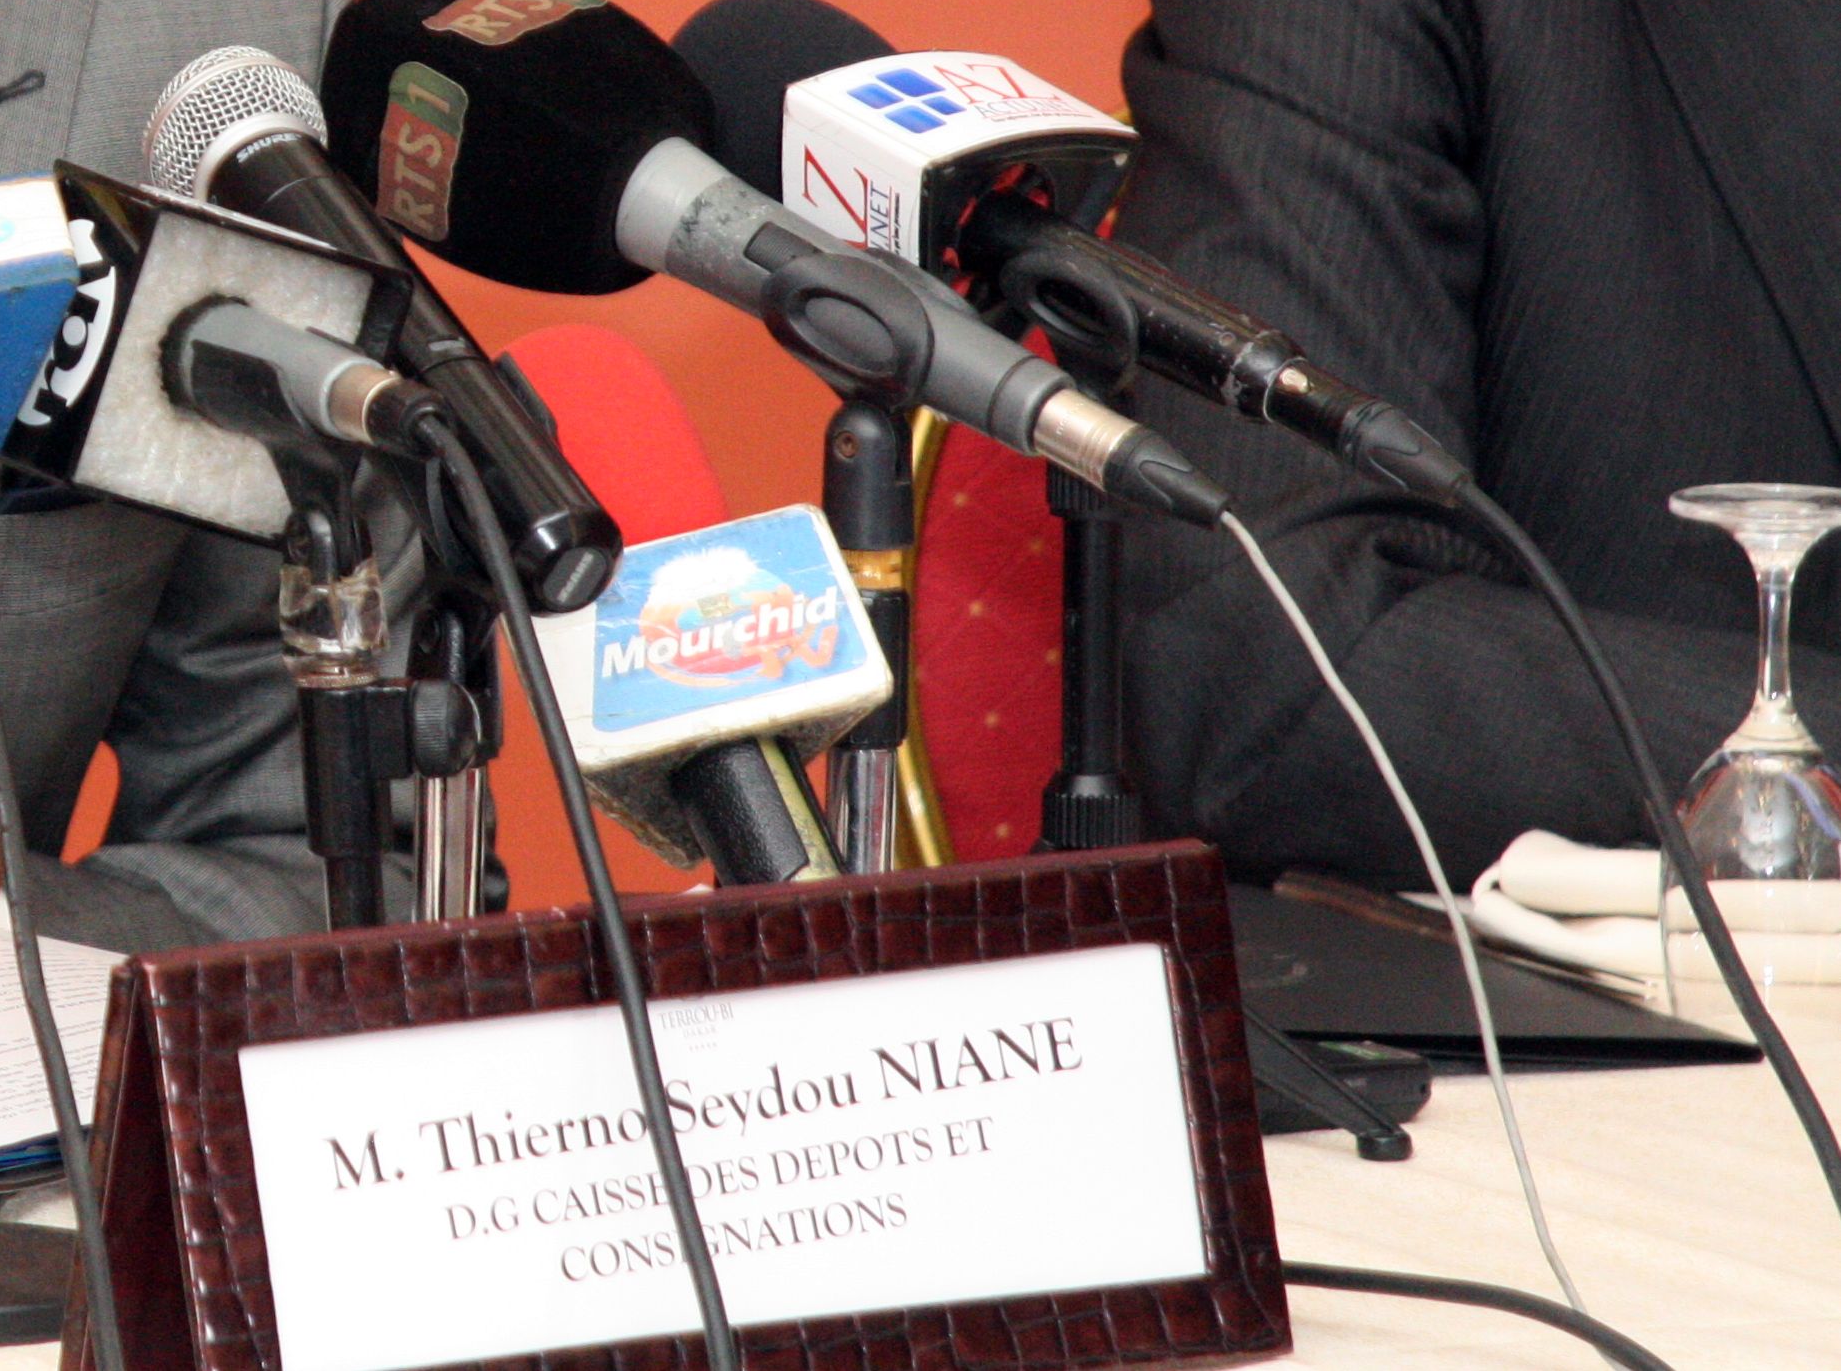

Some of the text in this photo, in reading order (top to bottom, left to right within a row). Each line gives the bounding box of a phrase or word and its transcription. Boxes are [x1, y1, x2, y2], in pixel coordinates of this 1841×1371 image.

[933, 64, 1062, 105] AZ
[236, 132, 298, 164] SHURE
[802, 144, 869, 251] Z
[601, 585, 838, 678] Mourchid
[324, 1016, 1083, 1190] M. Thierno Seydou NIANE
[445, 1116, 994, 1241] D.G CAISSE DES DEPOTS ET
